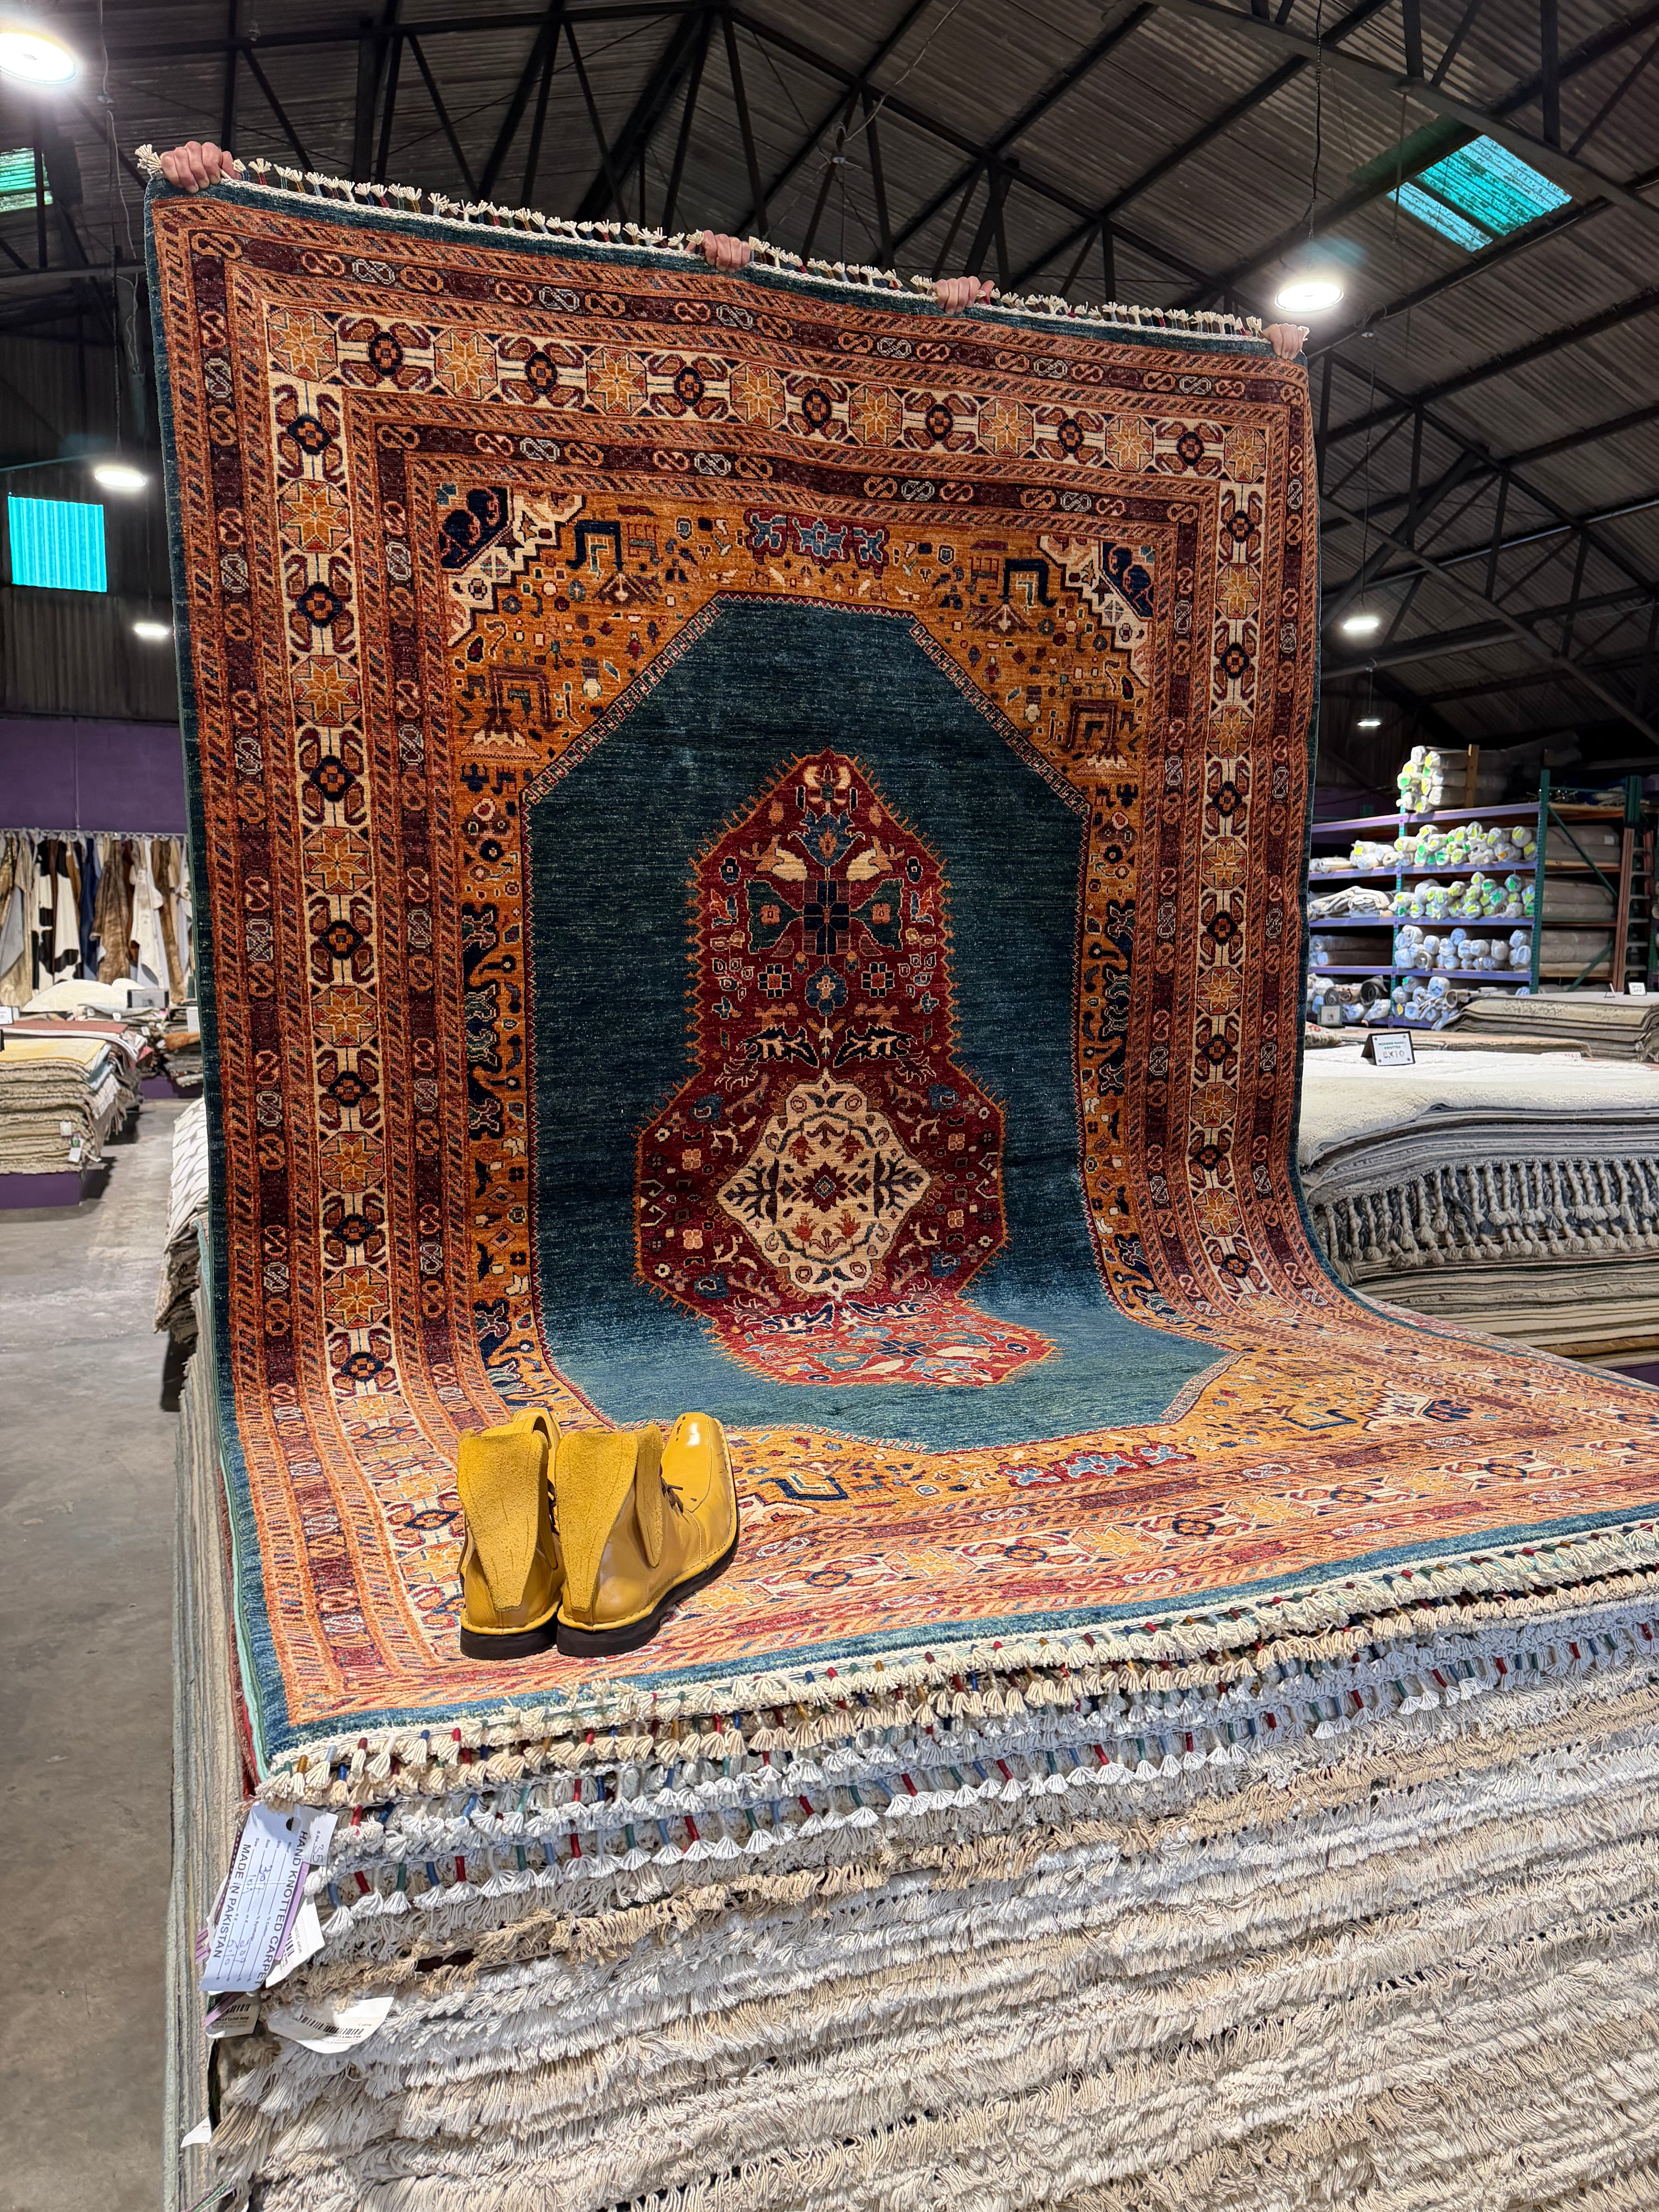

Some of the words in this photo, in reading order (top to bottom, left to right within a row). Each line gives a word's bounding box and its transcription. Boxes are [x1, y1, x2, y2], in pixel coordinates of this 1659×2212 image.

[235, 1844, 251, 1879] MADE
[292, 1831, 308, 1866] HAND
[312, 1844, 325, 1863] 35
[231, 1882, 241, 1894] IN
[273, 1870, 298, 1932] KNOTTED
[213, 1898, 236, 1958] PAKISTAN
[254, 1937, 278, 1985] CARPET
